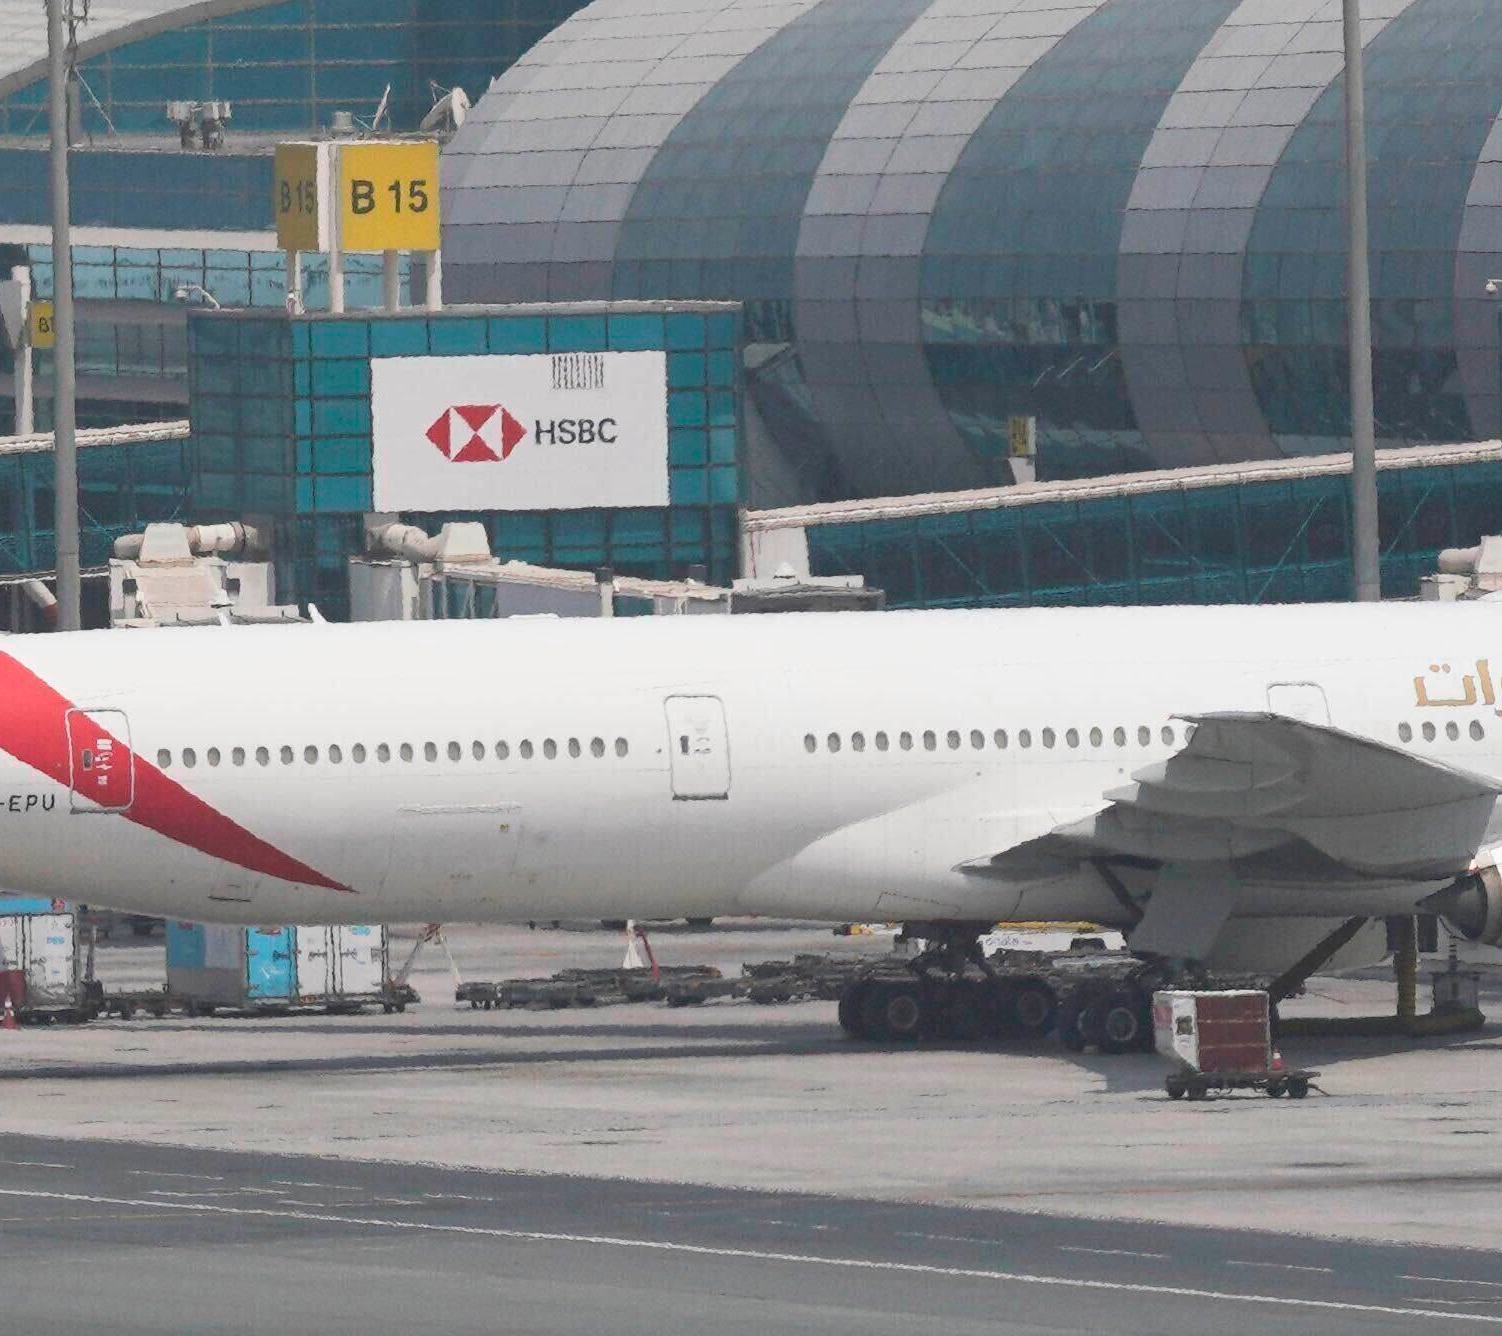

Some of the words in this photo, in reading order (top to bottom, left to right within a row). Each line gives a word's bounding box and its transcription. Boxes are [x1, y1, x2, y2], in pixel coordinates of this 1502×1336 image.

[351, 179, 375, 214] B
[388, 179, 428, 213] 15
[535, 418, 617, 445] HSBC
